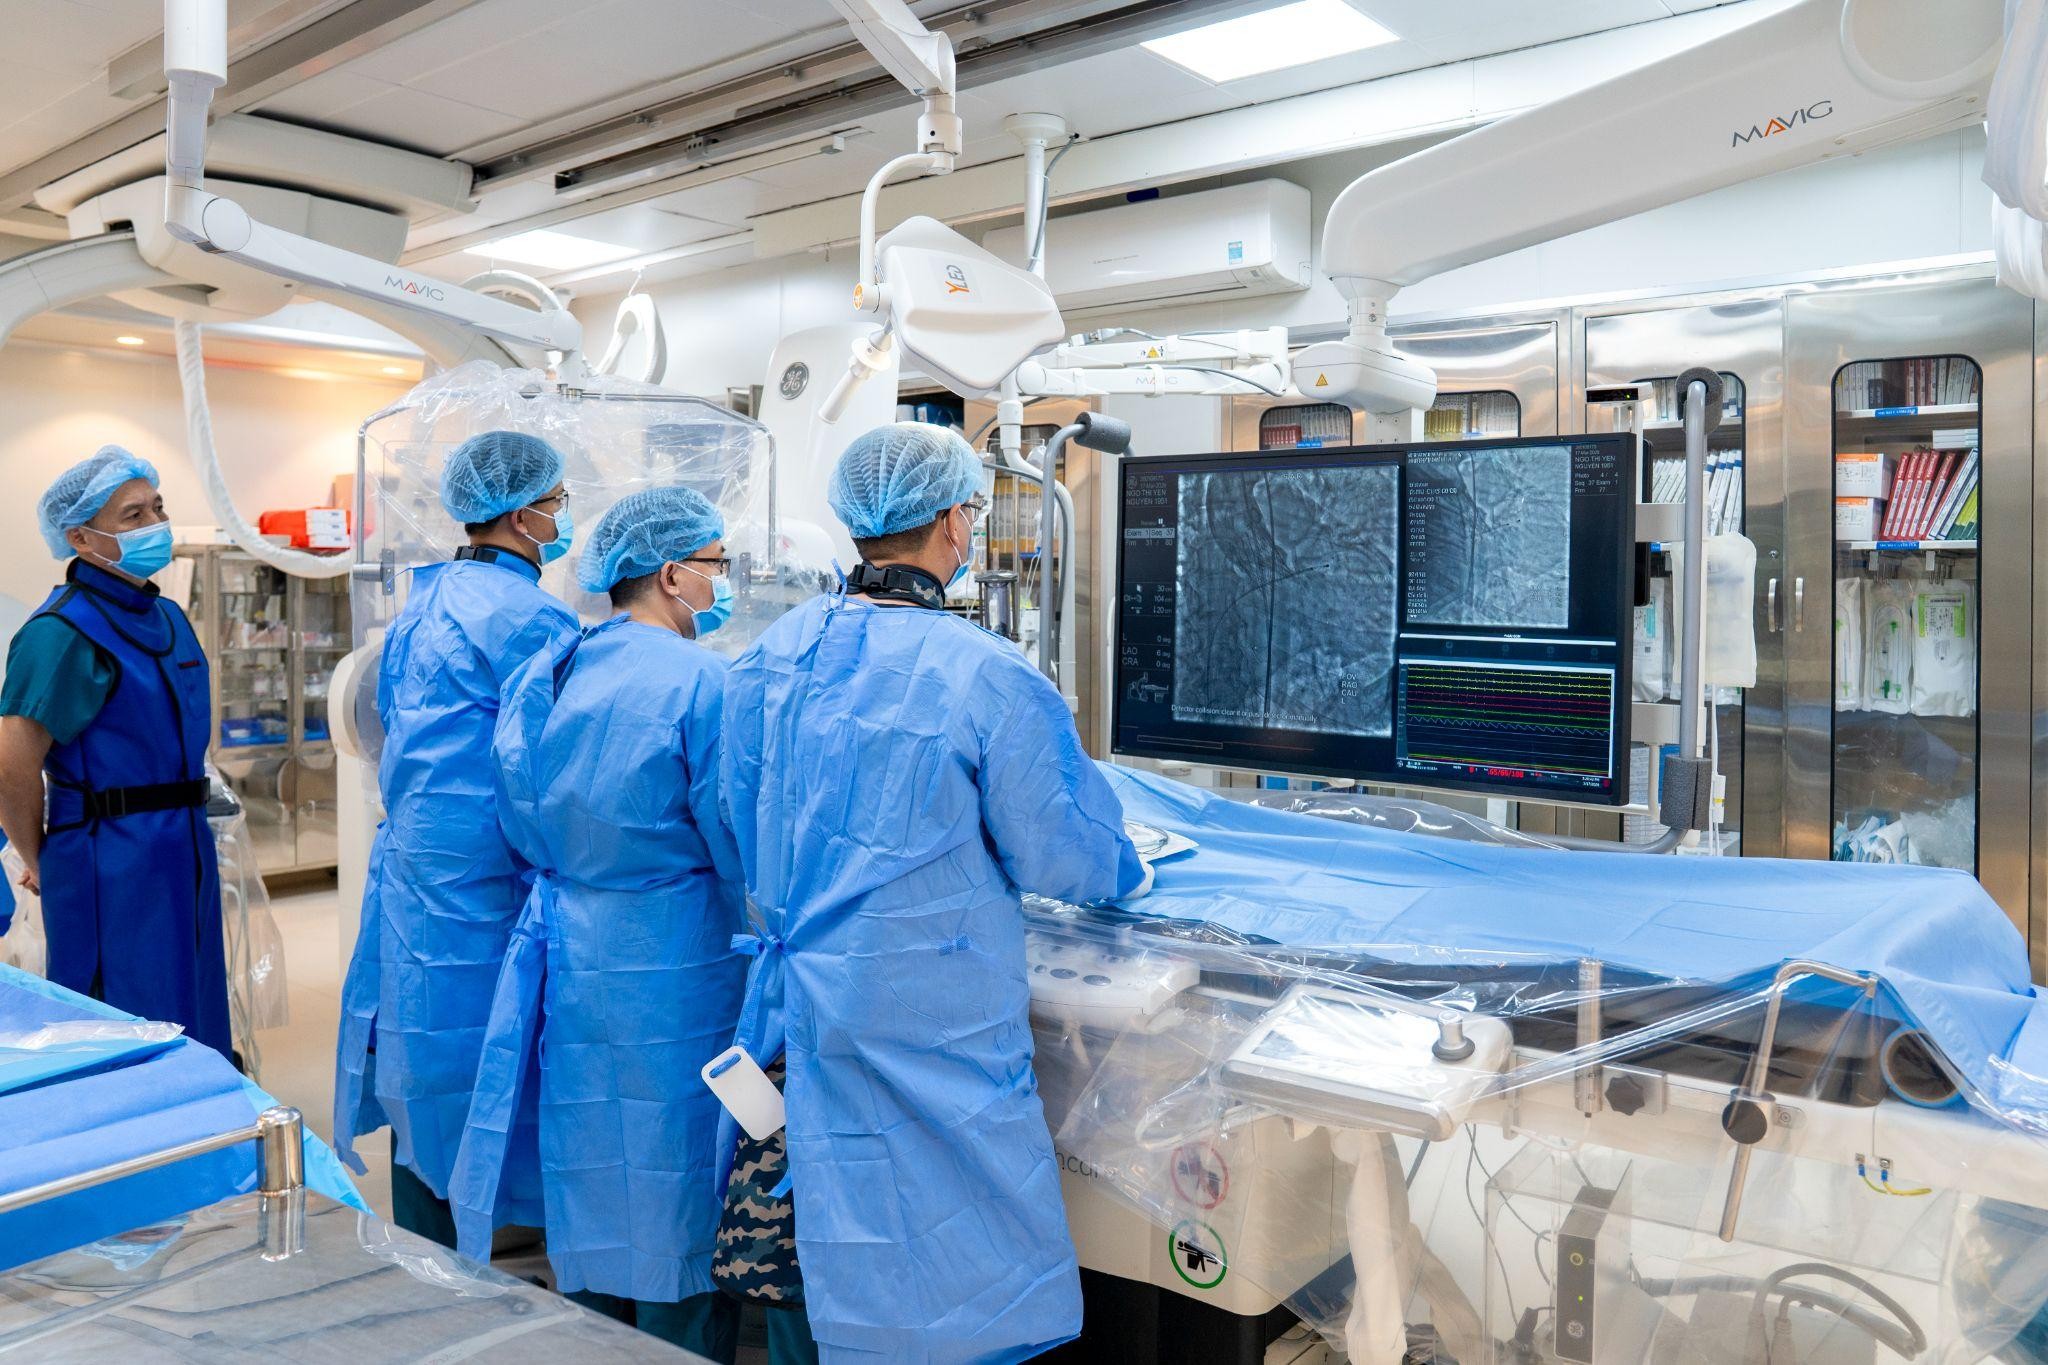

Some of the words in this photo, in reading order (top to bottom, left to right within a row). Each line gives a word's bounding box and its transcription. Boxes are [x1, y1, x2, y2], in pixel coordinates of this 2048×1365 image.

[1732, 100, 1833, 147] MAVIG
[384, 274, 444, 301] MAVIG
[1135, 376, 1178, 385] MAIG
[1126, 489, 1141, 497] NGO
[1122, 646, 1138, 655] LAO
[1121, 657, 1139, 666] CRA
[1341, 681, 1358, 689] RAO
[1341, 689, 1357, 697] CAU
